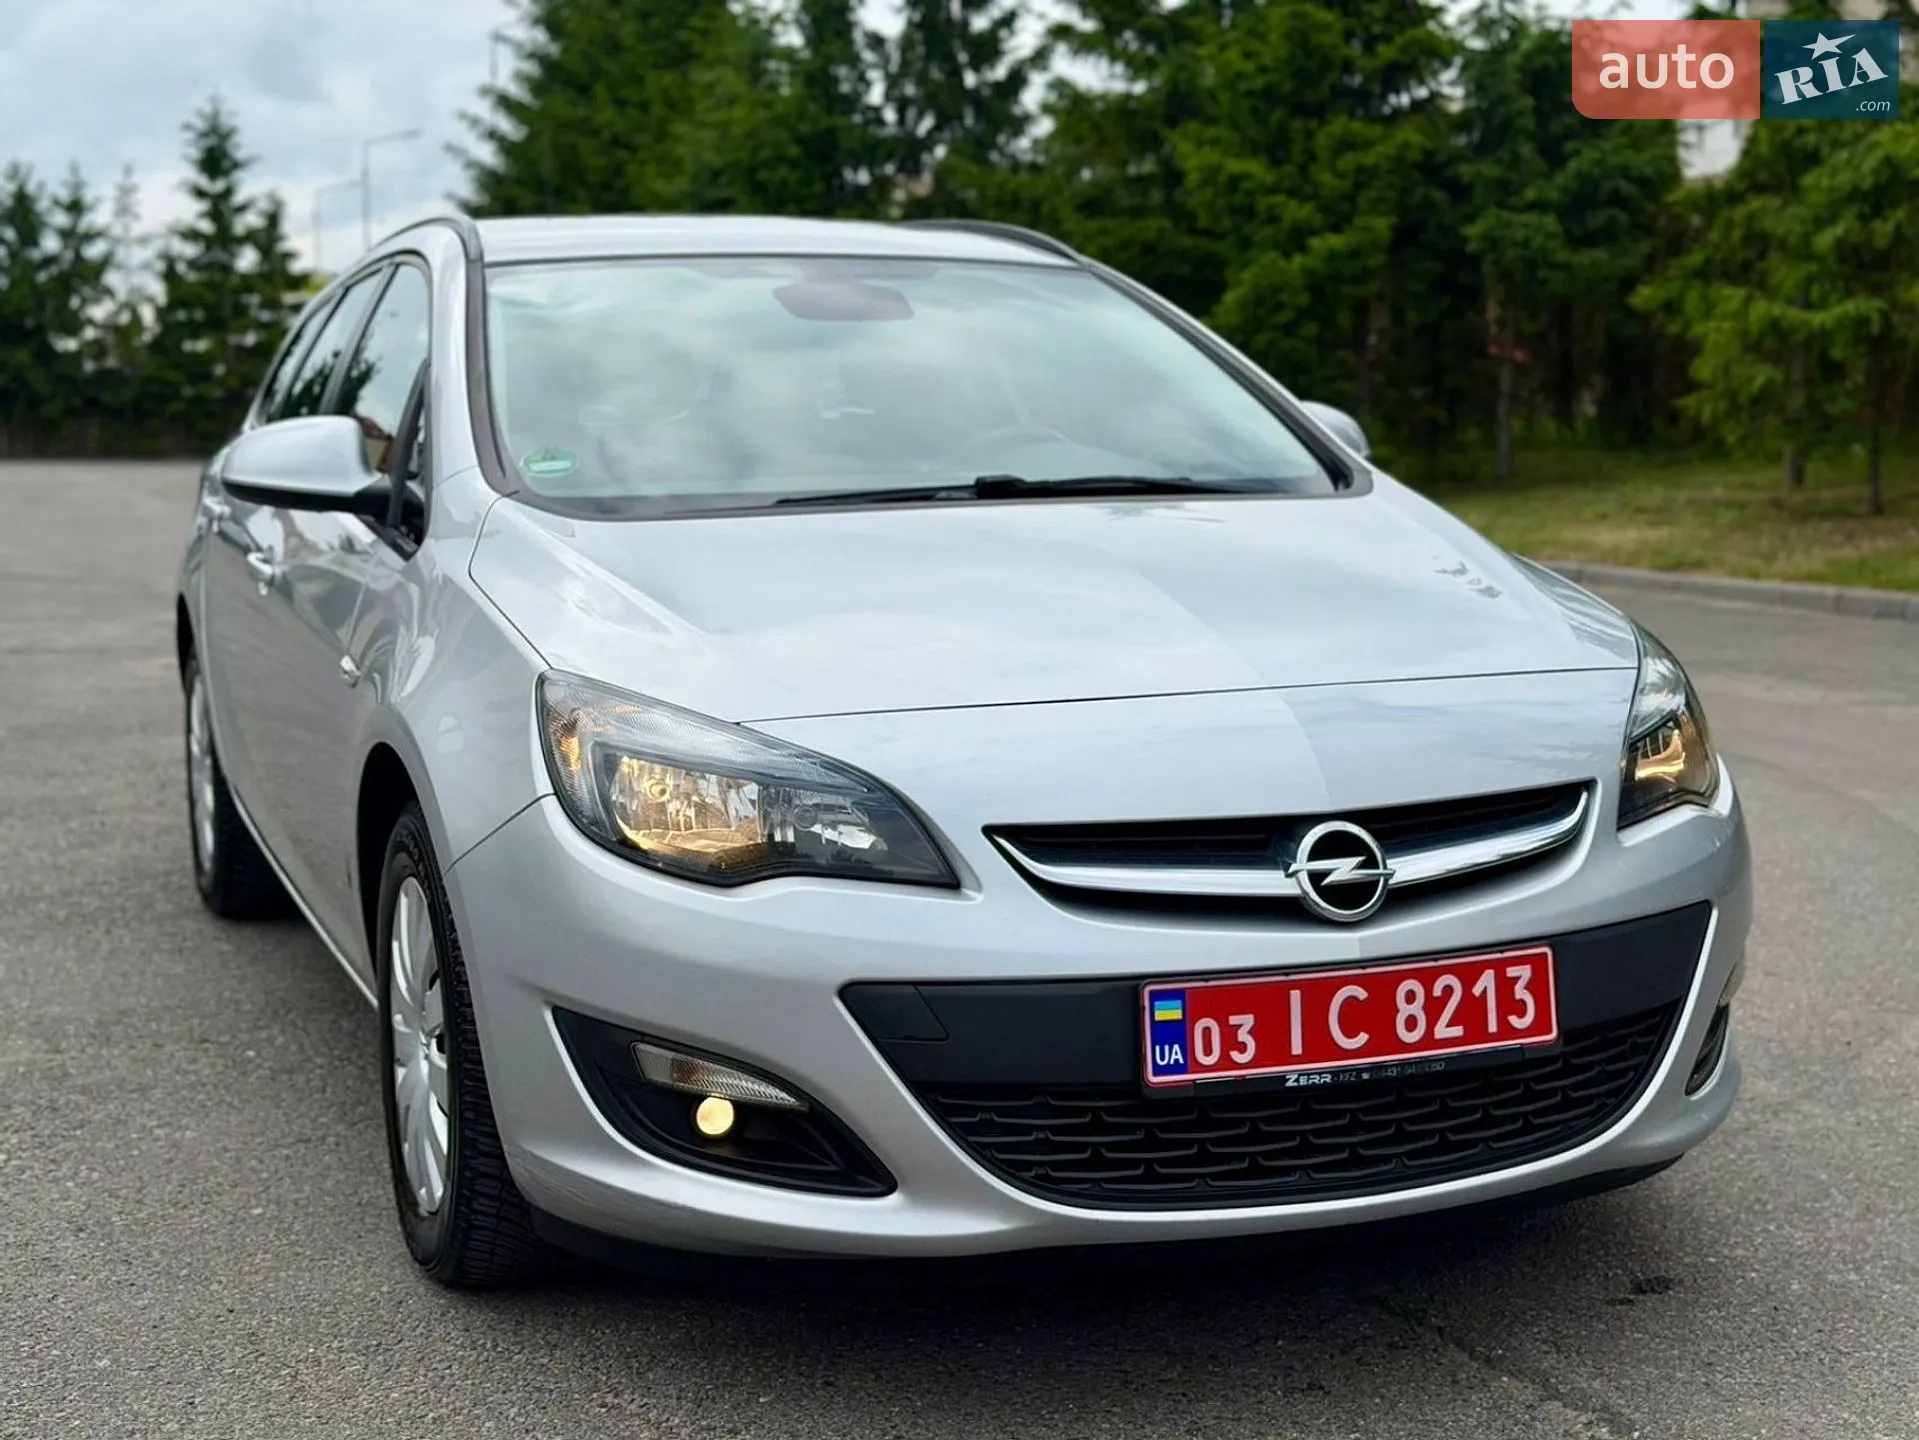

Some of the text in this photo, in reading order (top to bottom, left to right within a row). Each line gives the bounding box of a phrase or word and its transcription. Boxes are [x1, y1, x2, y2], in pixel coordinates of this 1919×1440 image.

[1192, 1014, 1256, 1066] 03
[1394, 964, 1536, 1044] 8213
[1154, 1044, 1184, 1067] UA
[1285, 1073, 1332, 1087] ZERR
